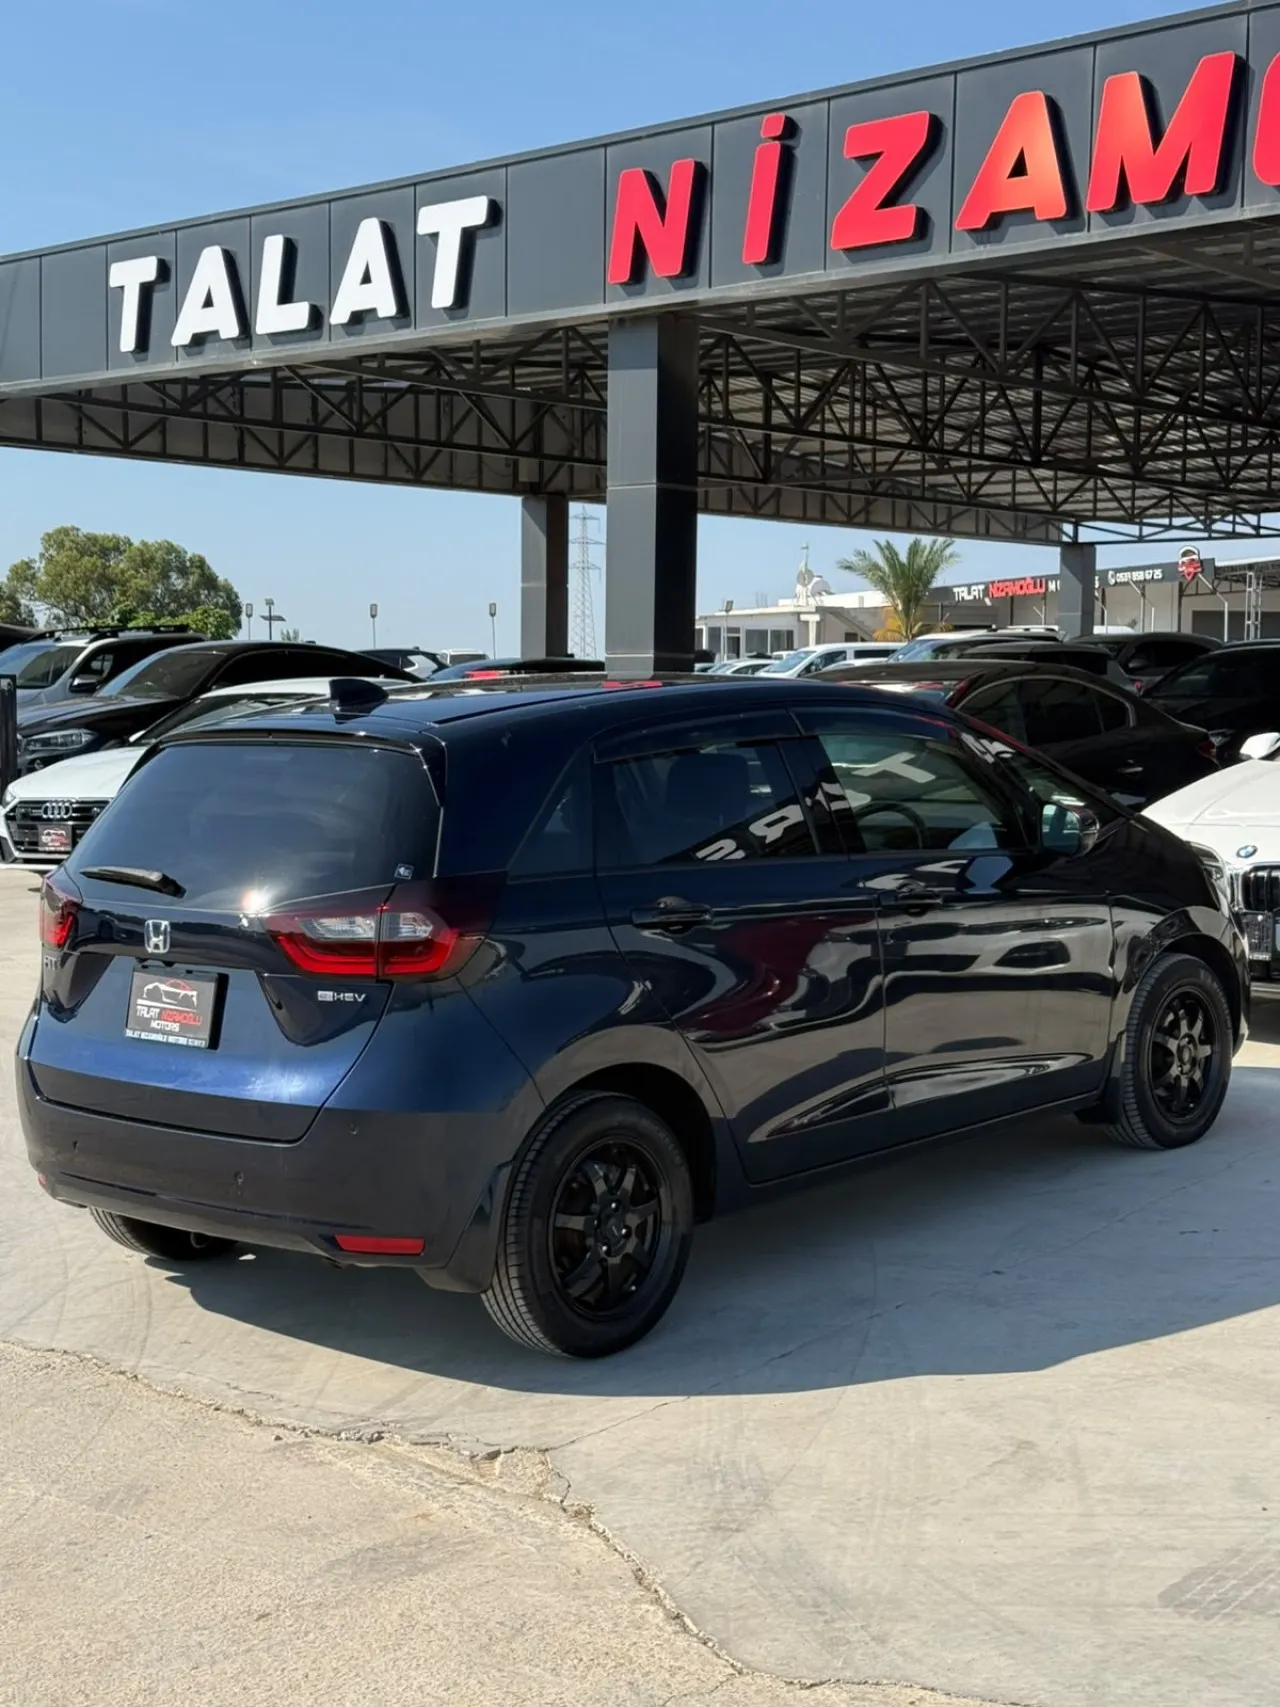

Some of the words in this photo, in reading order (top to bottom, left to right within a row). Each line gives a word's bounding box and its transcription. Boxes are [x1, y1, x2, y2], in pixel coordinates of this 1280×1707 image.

[109, 195, 490, 353] TALAT
[953, 584, 985, 602] TALAT
[136, 1005, 160, 1019] TALAT
